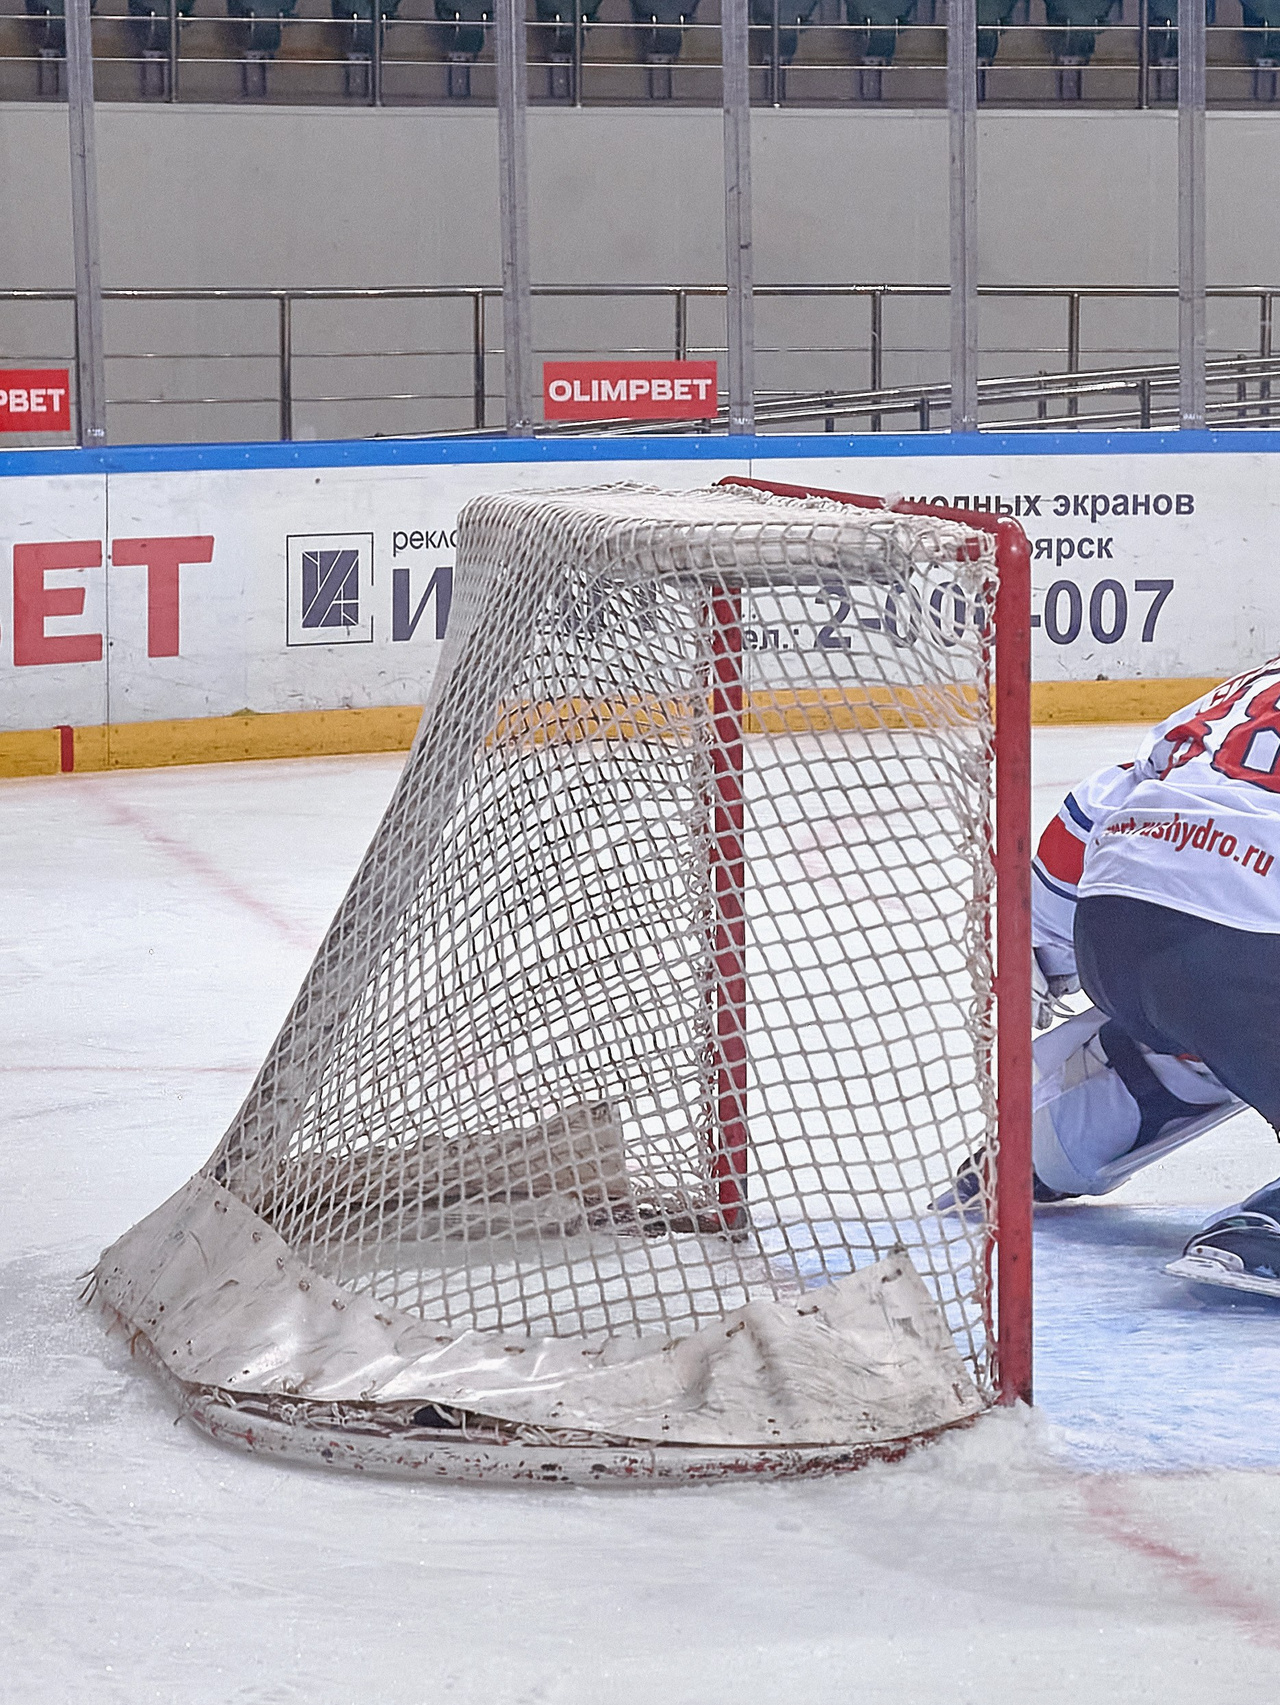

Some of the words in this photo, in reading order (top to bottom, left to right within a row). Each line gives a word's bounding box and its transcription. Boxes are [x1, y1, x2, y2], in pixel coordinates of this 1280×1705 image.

[548, 378, 713, 402] OLIMPBET
[1052, 493, 1195, 523] экранов
[1030, 536, 1114, 566] ярск
[0, 535, 215, 667] ET
[814, 579, 1175, 647] 2-00-007
